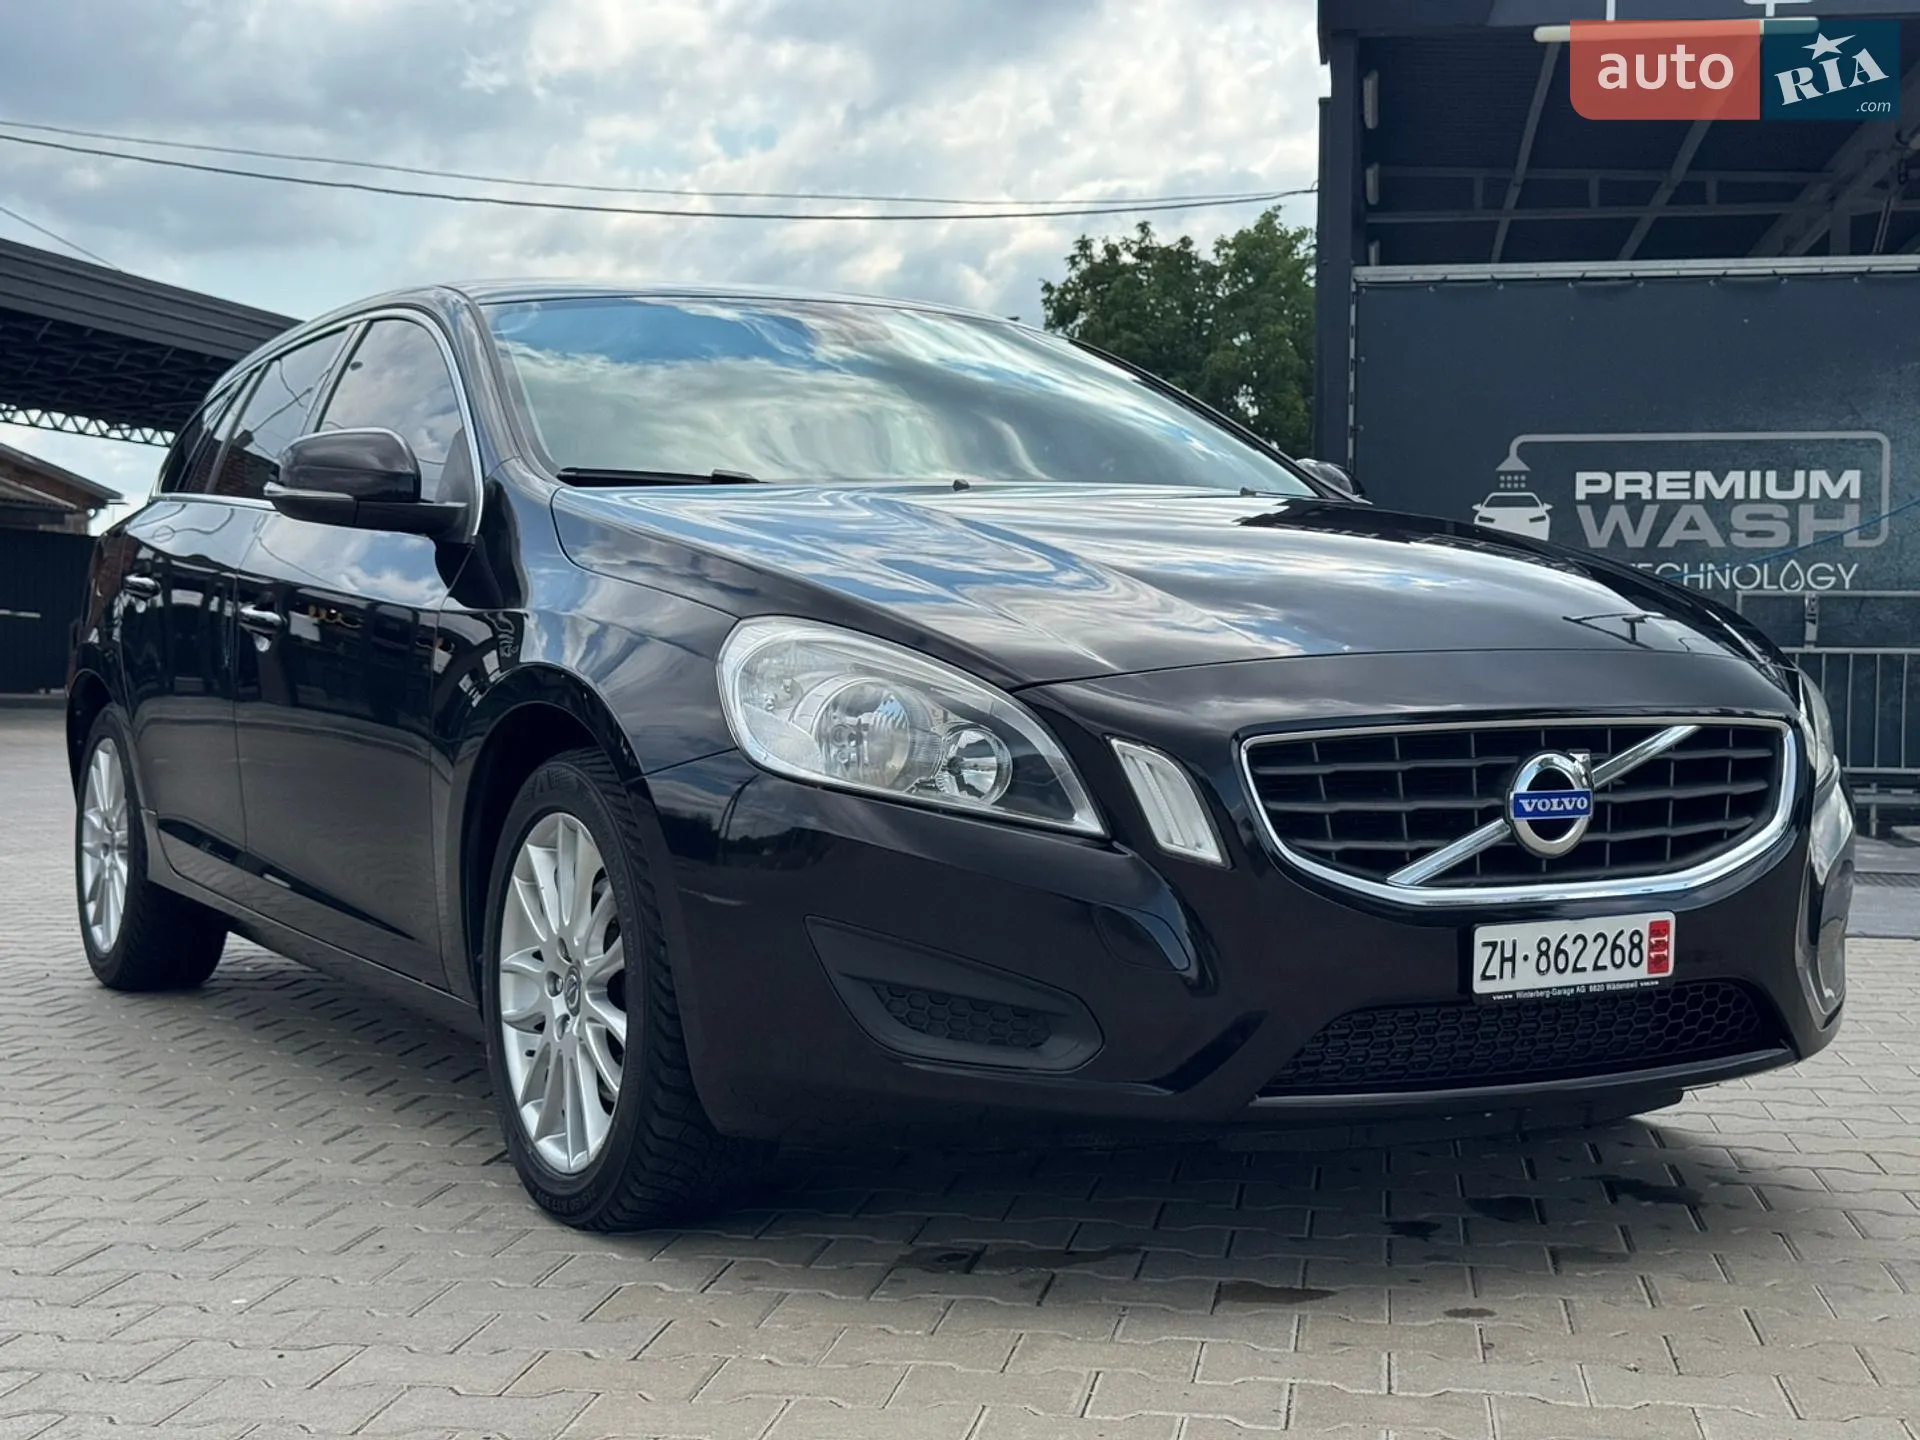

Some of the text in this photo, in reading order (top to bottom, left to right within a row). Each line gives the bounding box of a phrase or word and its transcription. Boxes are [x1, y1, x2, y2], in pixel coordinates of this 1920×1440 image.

[1575, 470, 1860, 500] PREMIUM
[1576, 504, 1860, 548] WASH
[1629, 559, 1859, 592] HNOLOGY
[1519, 796, 1588, 812] VOLVO
